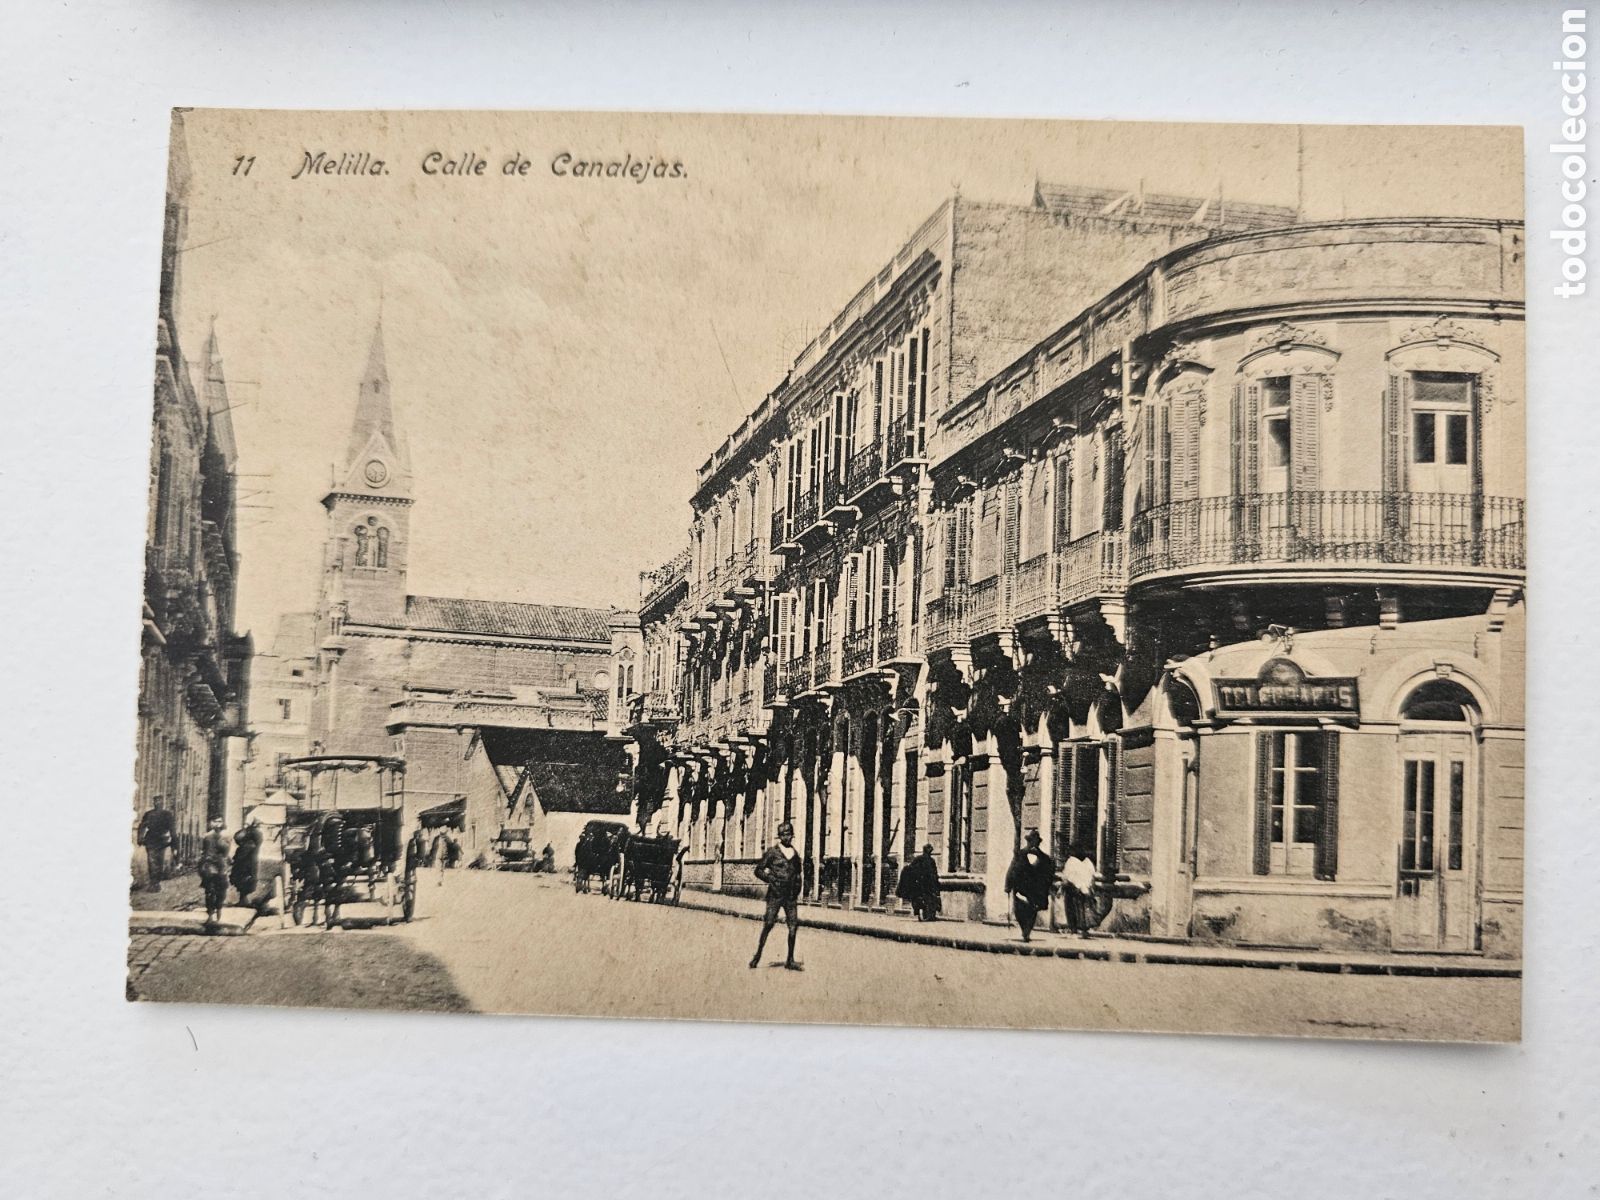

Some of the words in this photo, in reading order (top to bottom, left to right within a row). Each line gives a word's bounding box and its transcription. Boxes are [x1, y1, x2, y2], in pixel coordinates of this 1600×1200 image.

[231, 155, 256, 177] 11
[292, 151, 391, 179] Melilla.
[421, 152, 487, 176] Calle
[502, 152, 533, 176] de
[551, 153, 689, 184] Canalejas.
